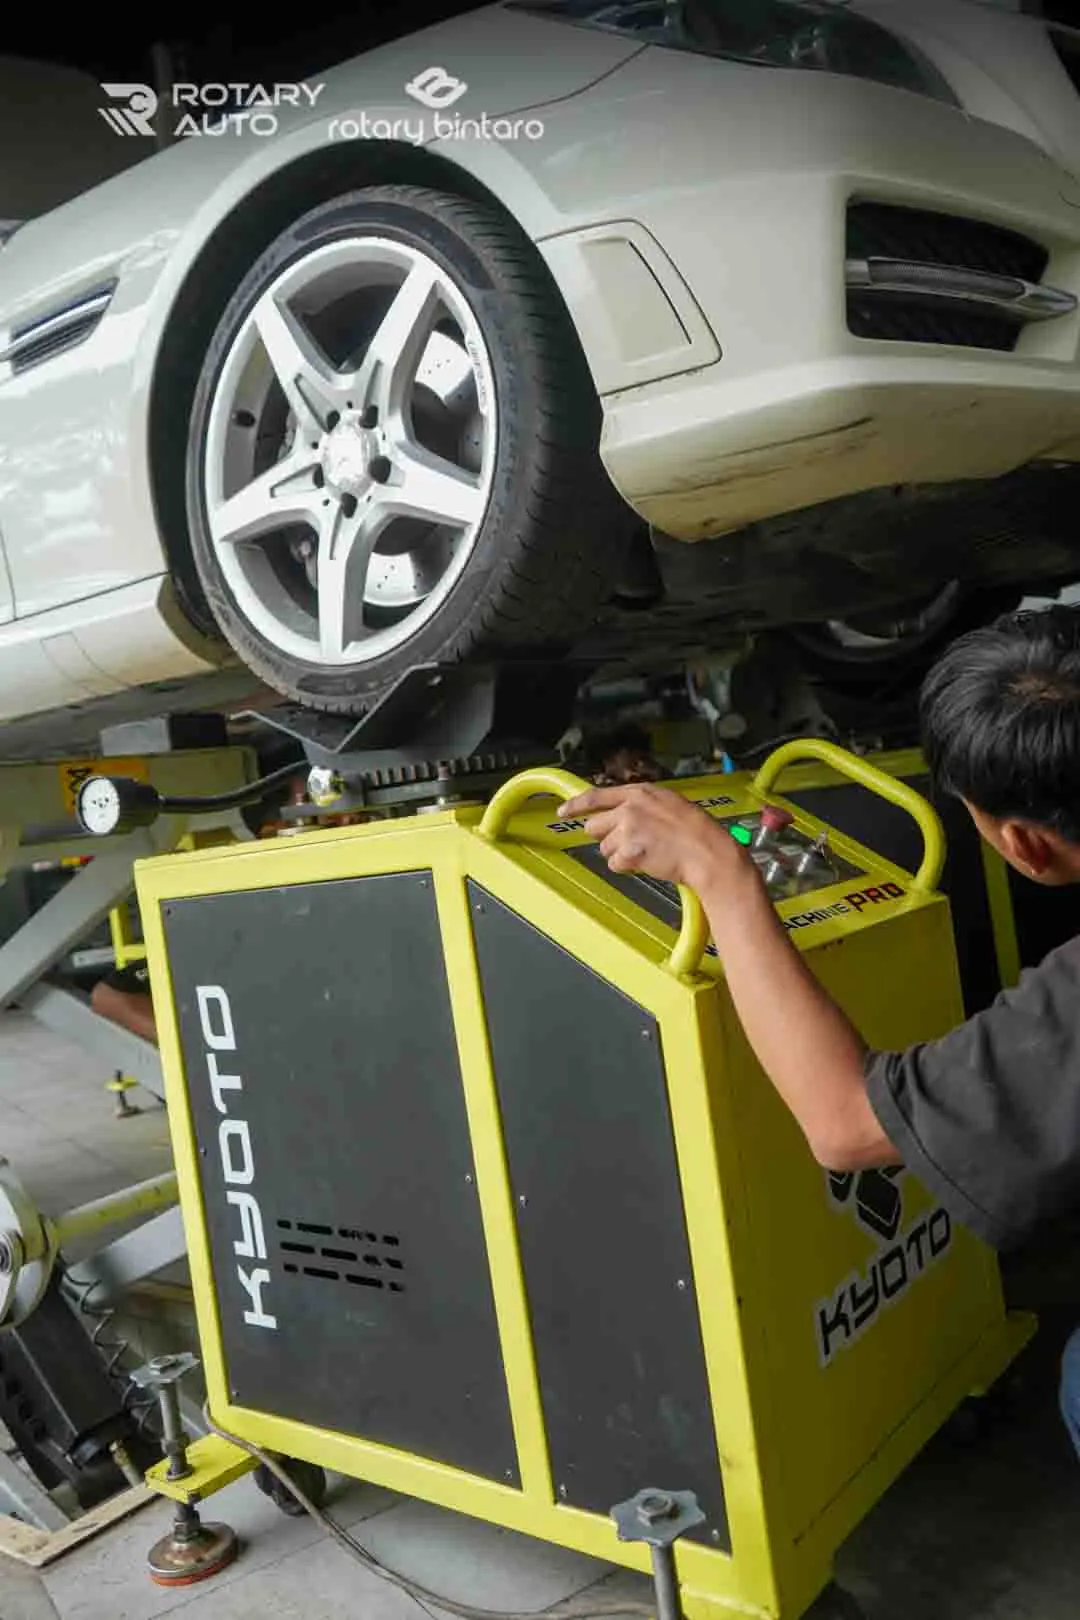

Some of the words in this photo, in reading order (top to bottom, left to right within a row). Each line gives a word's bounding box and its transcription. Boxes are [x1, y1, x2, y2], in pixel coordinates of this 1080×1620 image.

[844, 881, 905, 913] PRO
[195, 985, 277, 1330] KYOTO
[819, 1207, 951, 1356] KYOTO
